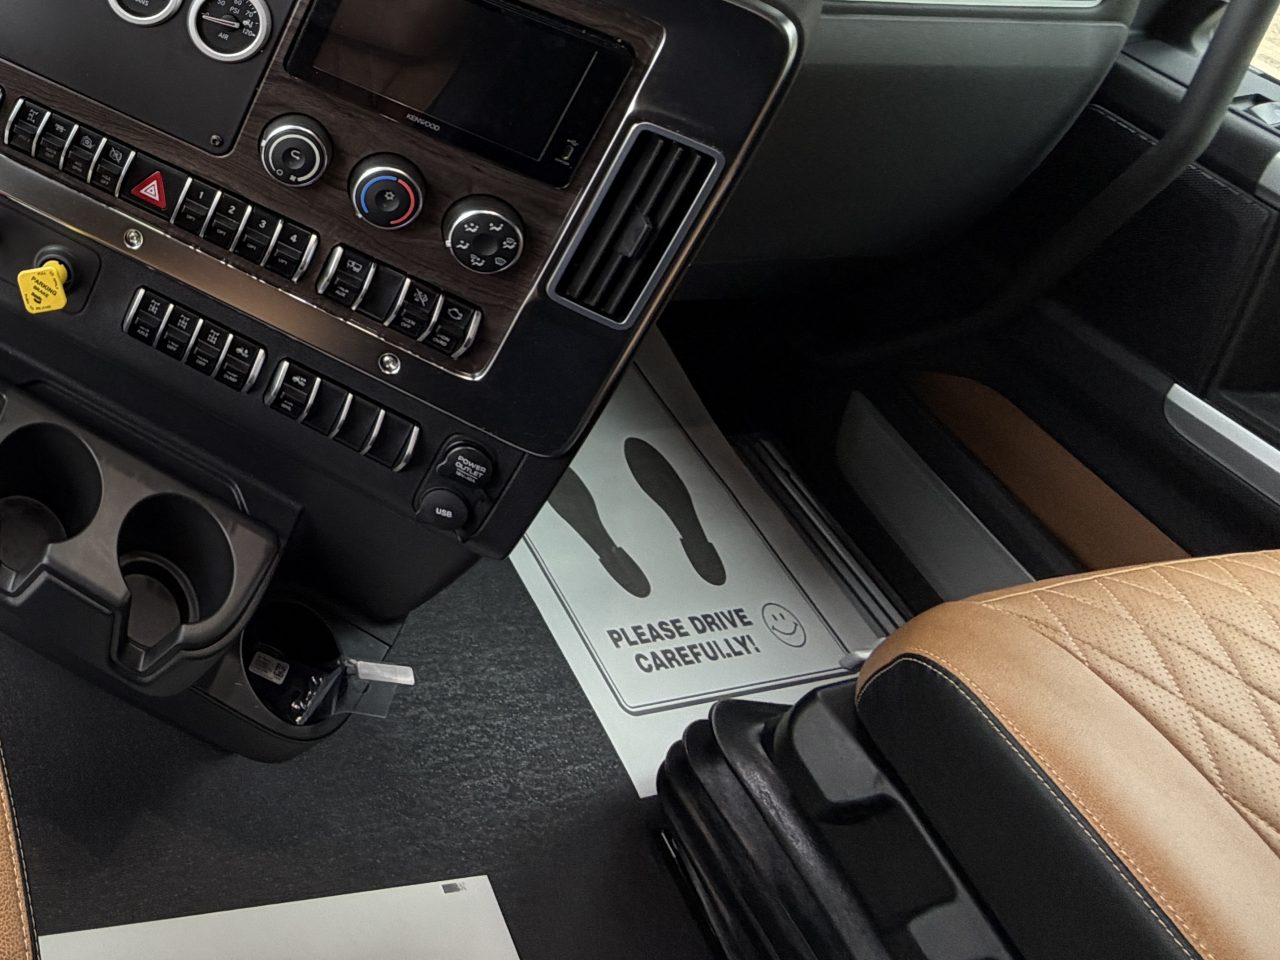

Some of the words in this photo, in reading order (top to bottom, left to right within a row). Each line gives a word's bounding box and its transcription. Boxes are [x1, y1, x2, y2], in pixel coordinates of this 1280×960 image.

[229, 6, 240, 15] PSI
[245, 9, 254, 18] 70
[217, 32, 229, 41] AIR
[242, 27, 253, 37] 120
[406, 113, 440, 131] KENWOOD
[199, 191, 204, 199] 1
[227, 205, 236, 215] 2
[258, 220, 267, 228] 3
[290, 234, 298, 243] 4
[31, 276, 57, 296] PARKING
[33, 285, 49, 298] BRAKE
[457, 455, 486, 473] POWER
[455, 461, 484, 478] OUTLET
[435, 507, 452, 518] USB
[606, 618, 690, 648] PLEASE
[687, 607, 754, 634] DRIVE
[634, 634, 761, 673] CAREFULLY!
